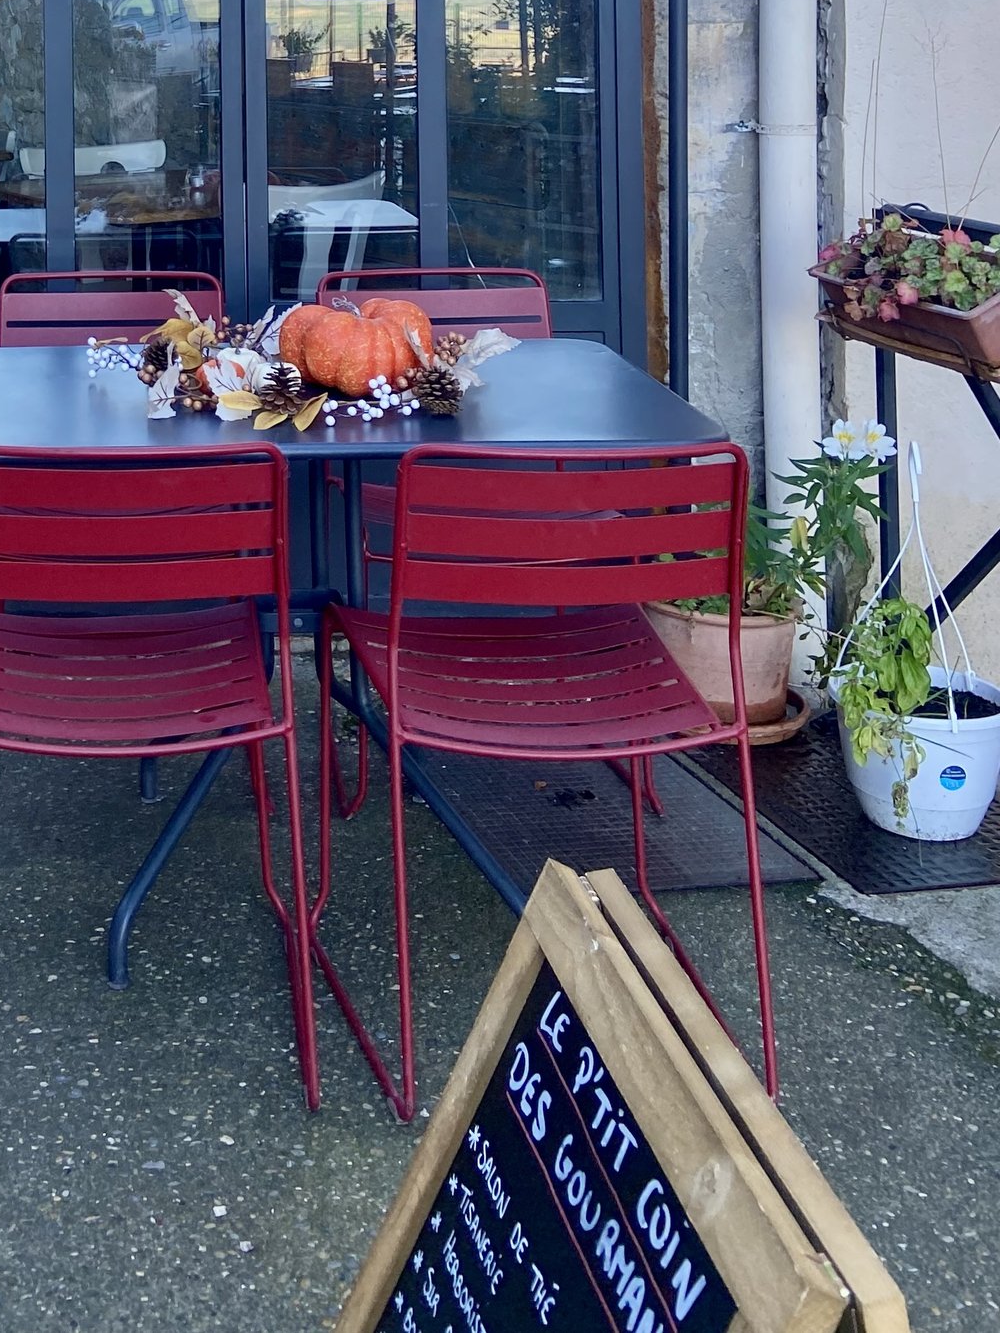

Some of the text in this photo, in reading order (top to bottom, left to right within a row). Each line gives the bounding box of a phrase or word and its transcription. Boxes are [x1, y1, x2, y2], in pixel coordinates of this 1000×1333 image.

[540, 991, 571, 1053] LE
[508, 1041, 552, 1141] DES
[477, 1139, 511, 1219] SALON
[510, 1221, 529, 1265] DE
